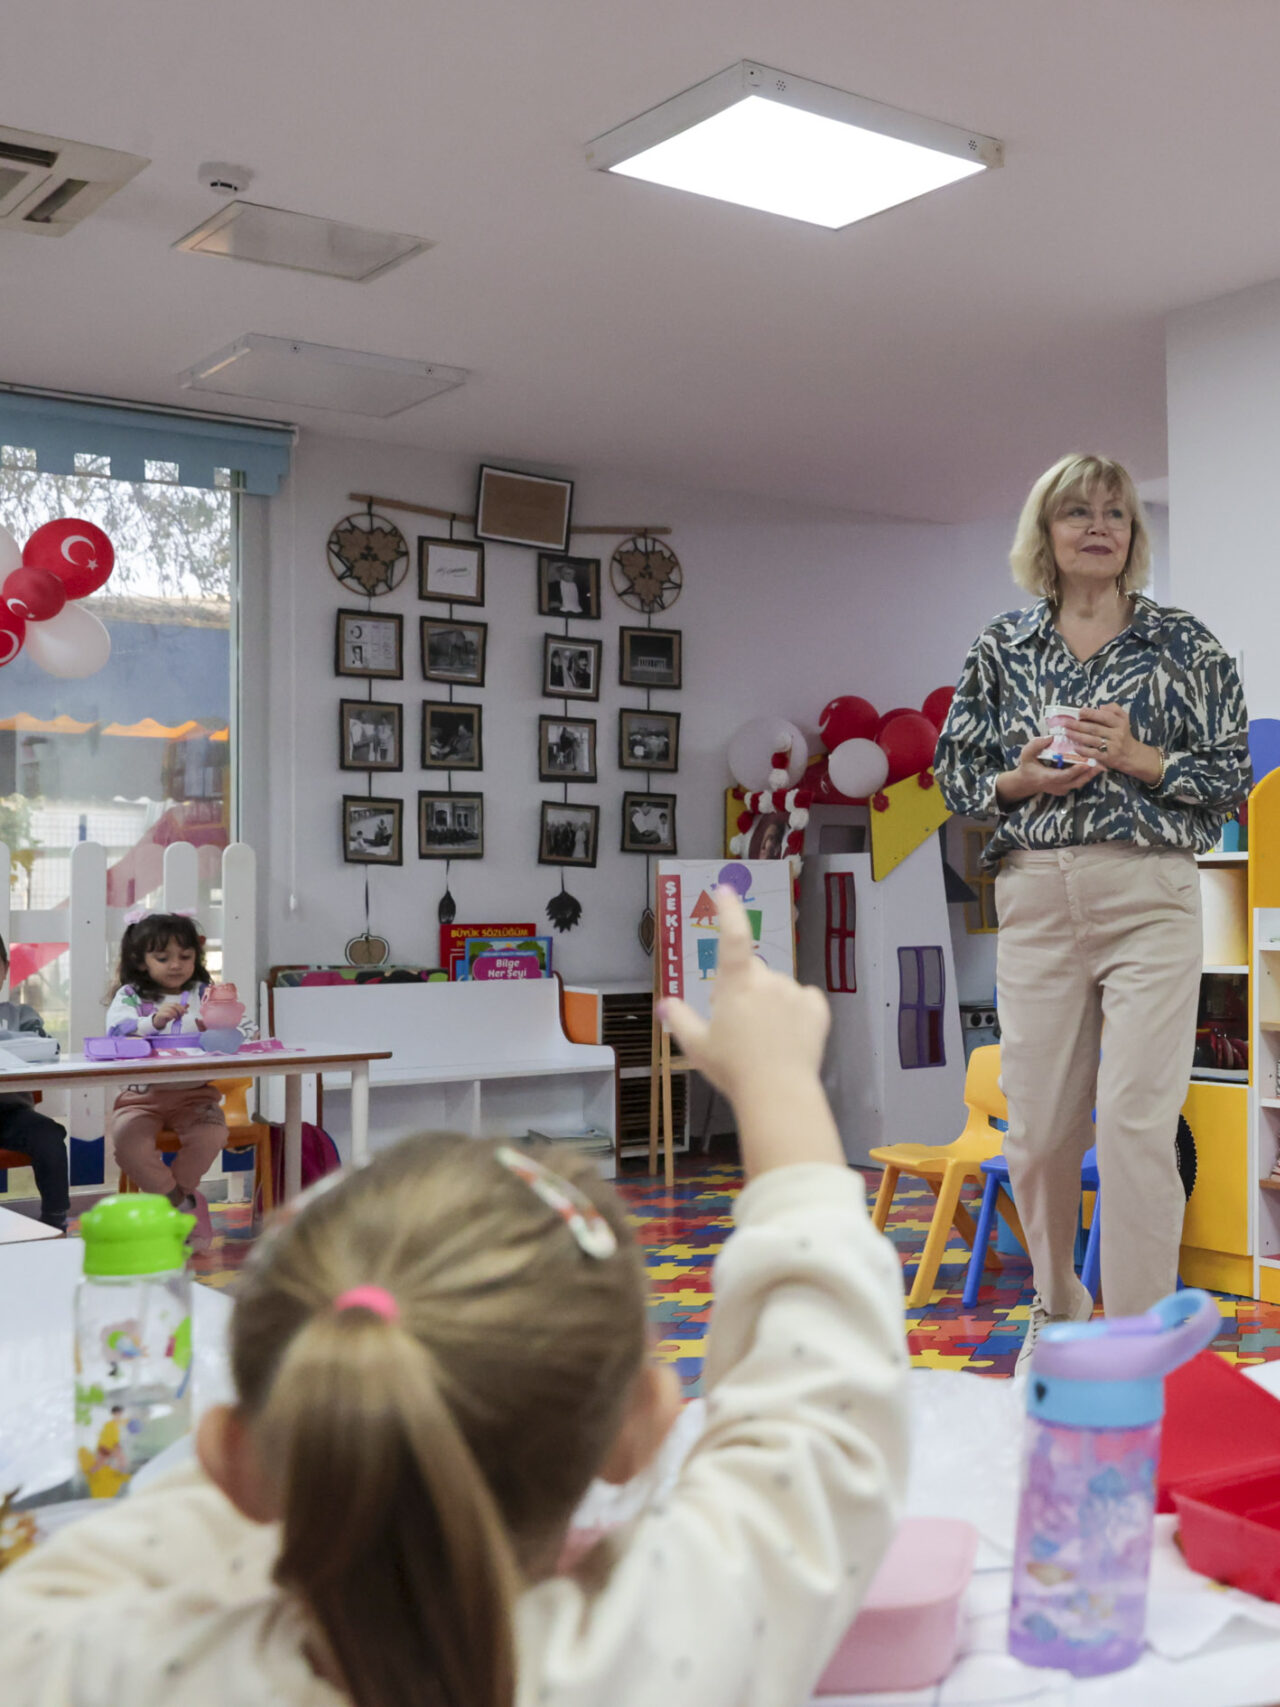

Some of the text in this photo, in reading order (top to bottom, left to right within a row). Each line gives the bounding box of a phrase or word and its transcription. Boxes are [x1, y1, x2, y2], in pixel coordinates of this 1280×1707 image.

[450, 927, 529, 938] BÜYÜK SÖZLÜĞÜM
[665, 881, 679, 994] ŞEKİLLE
[496, 959, 520, 969] Bilge
[488, 968, 527, 979] Her Şeyi
